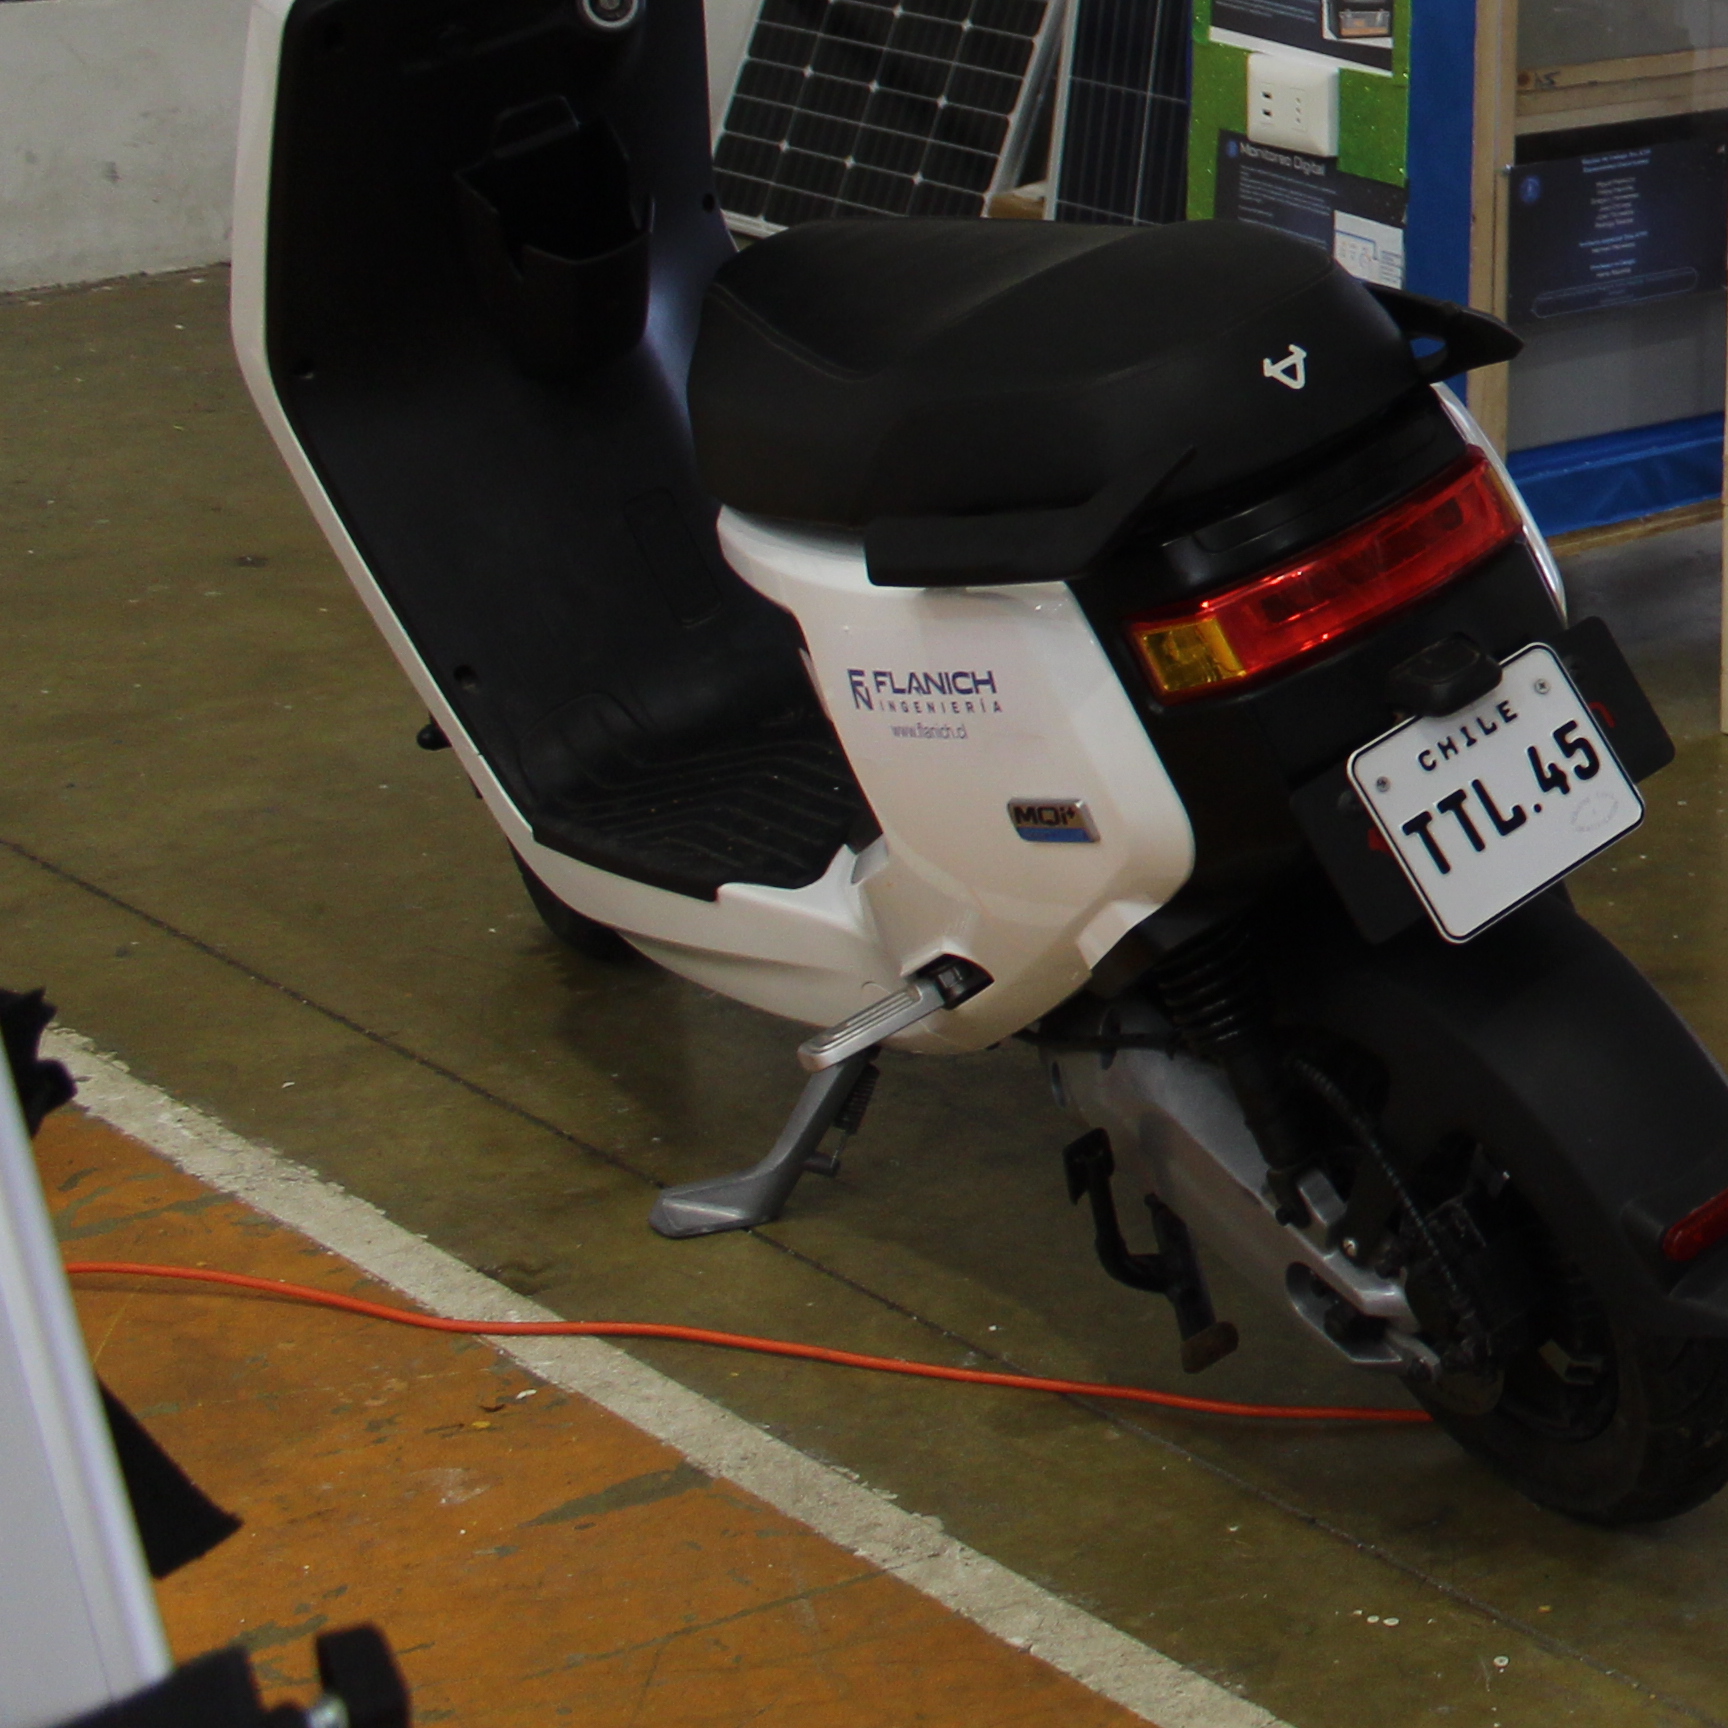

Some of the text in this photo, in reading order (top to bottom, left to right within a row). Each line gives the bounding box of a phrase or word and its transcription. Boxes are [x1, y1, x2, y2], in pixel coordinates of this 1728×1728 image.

[873, 670, 998, 696] FLANICH
[879, 698, 1003, 714] INGENIERÍA
[891, 722, 969, 740] www.flanich.cl
[1416, 699, 1519, 772] CHILE
